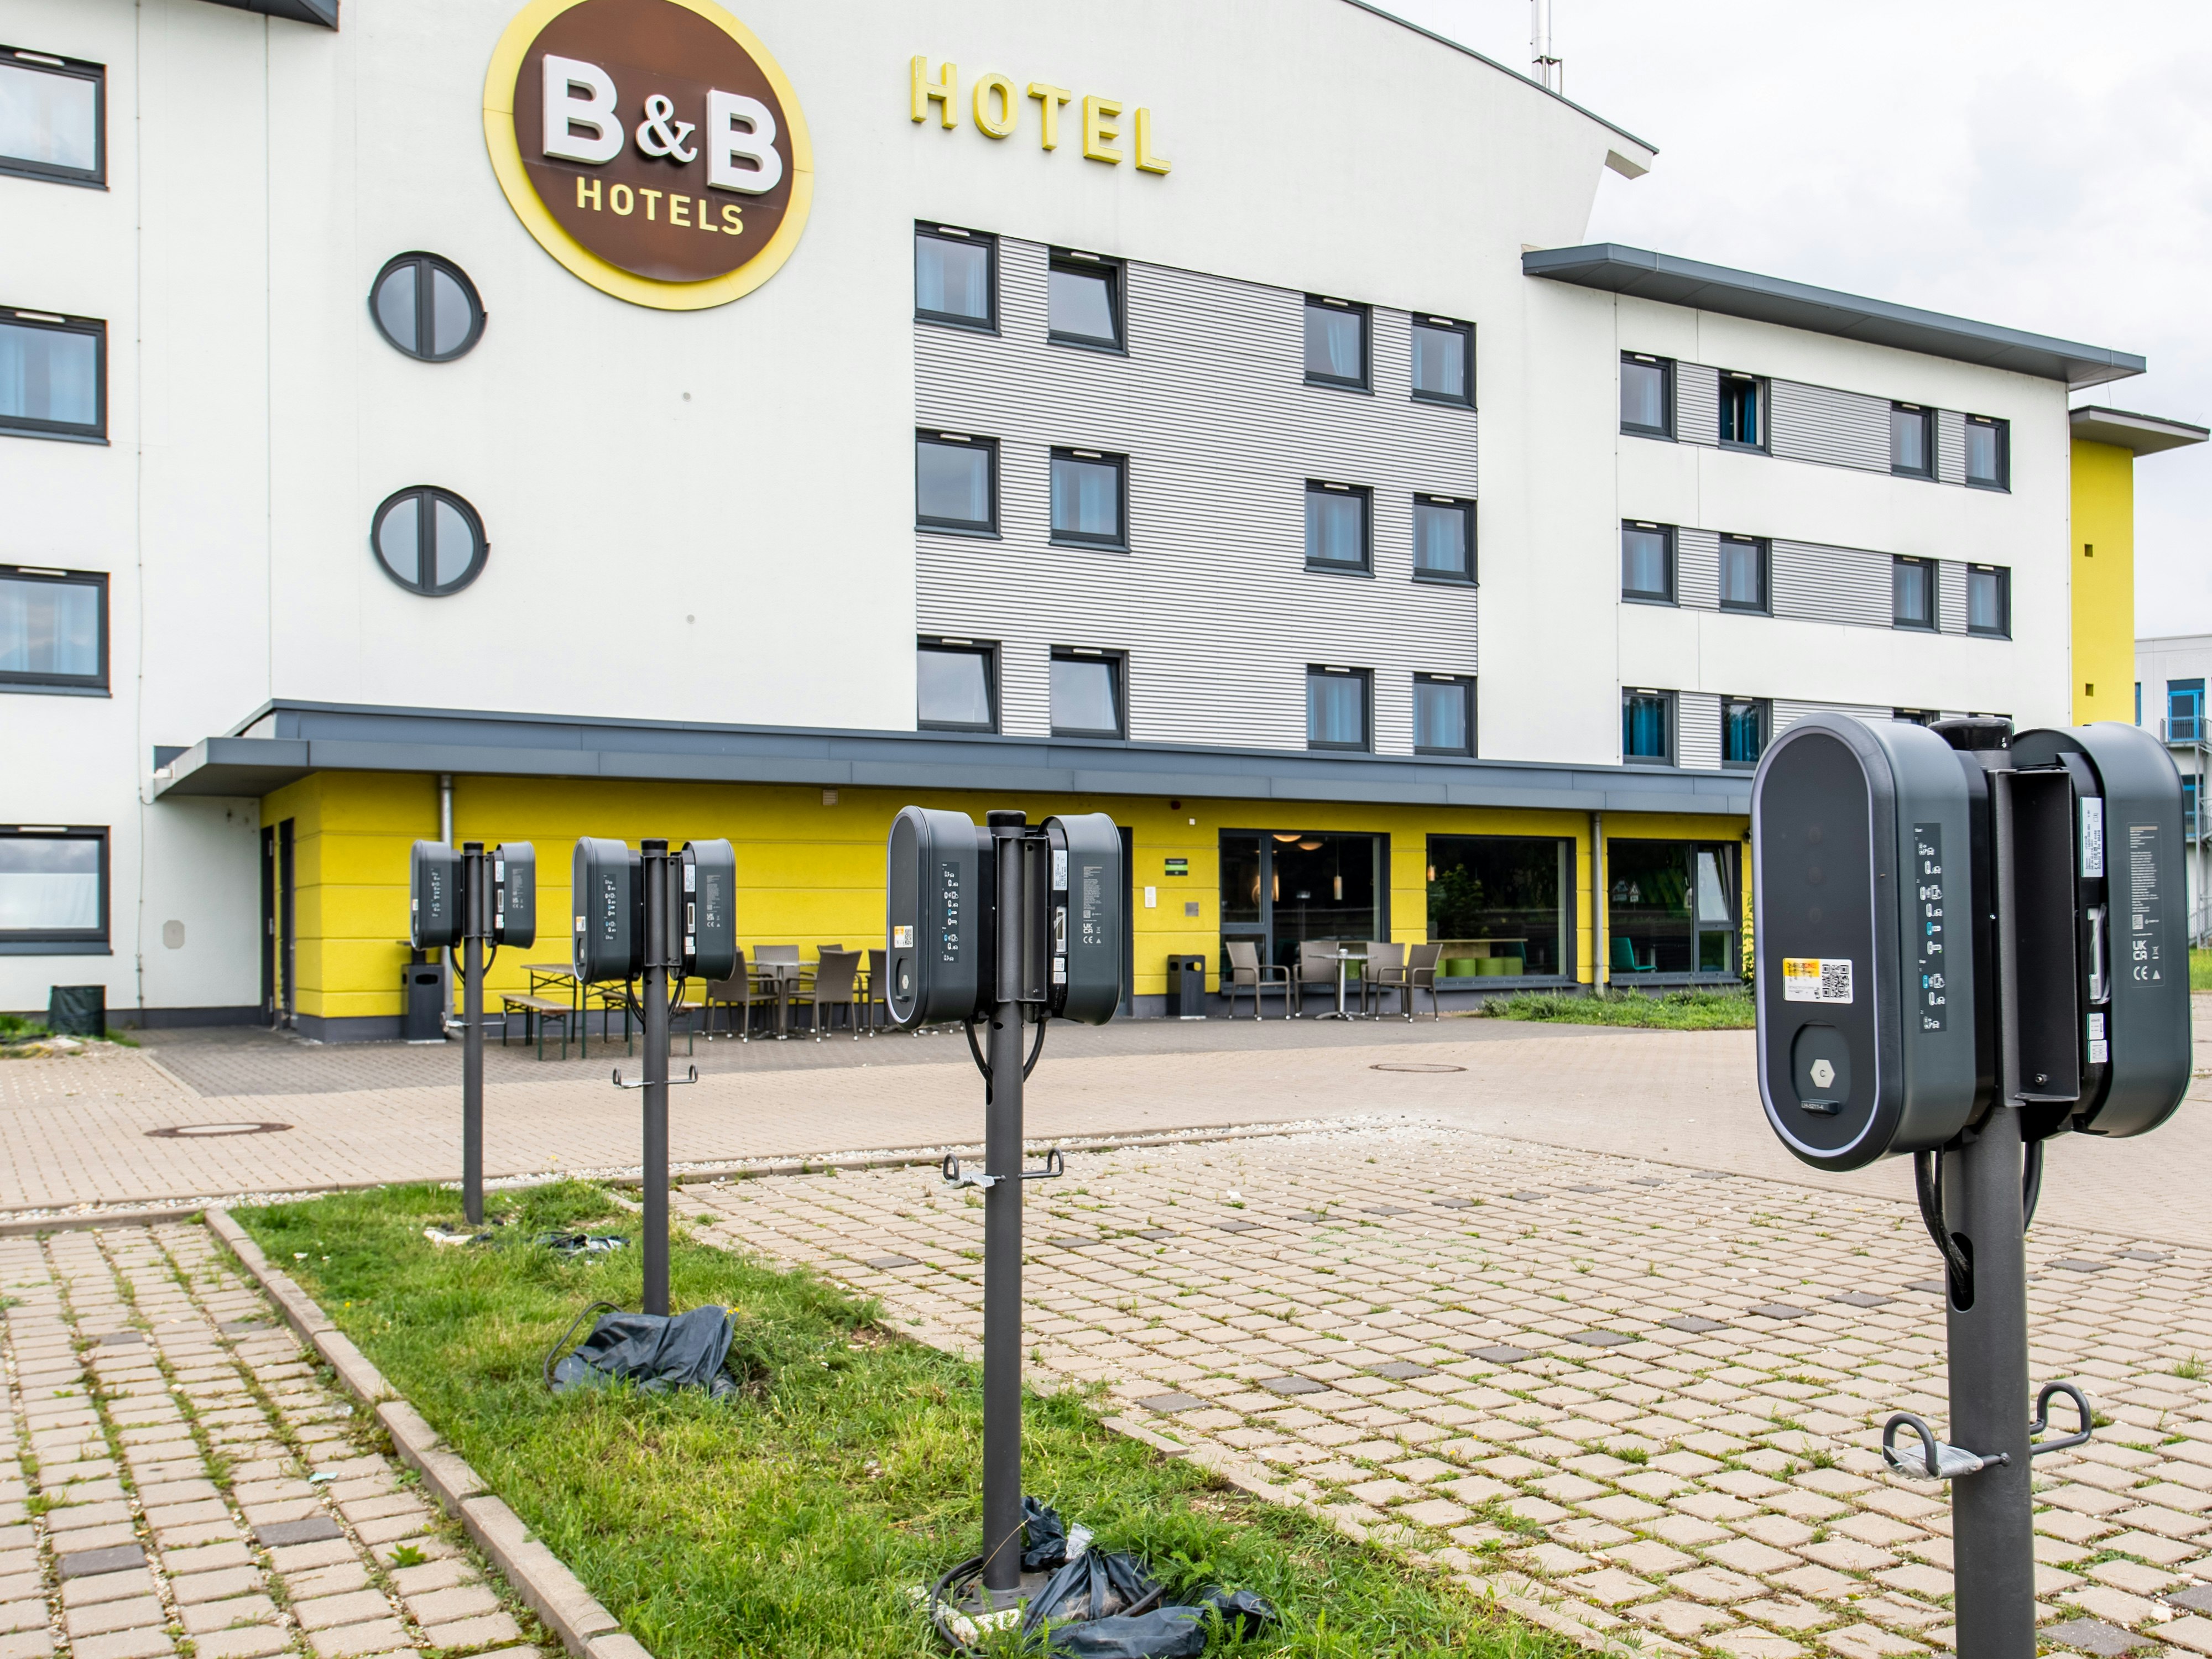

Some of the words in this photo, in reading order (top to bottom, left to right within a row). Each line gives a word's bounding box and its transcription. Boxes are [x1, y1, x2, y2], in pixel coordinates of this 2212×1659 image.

[911, 54, 1172, 175] HOTEL
[542, 54, 782, 195] B&B
[577, 176, 744, 236] HOTELS
[2132, 940, 2147, 950] UK
[2133, 951, 2147, 960] CA
[2133, 966, 2148, 980] CE
[1819, 1069, 1825, 1077] C
